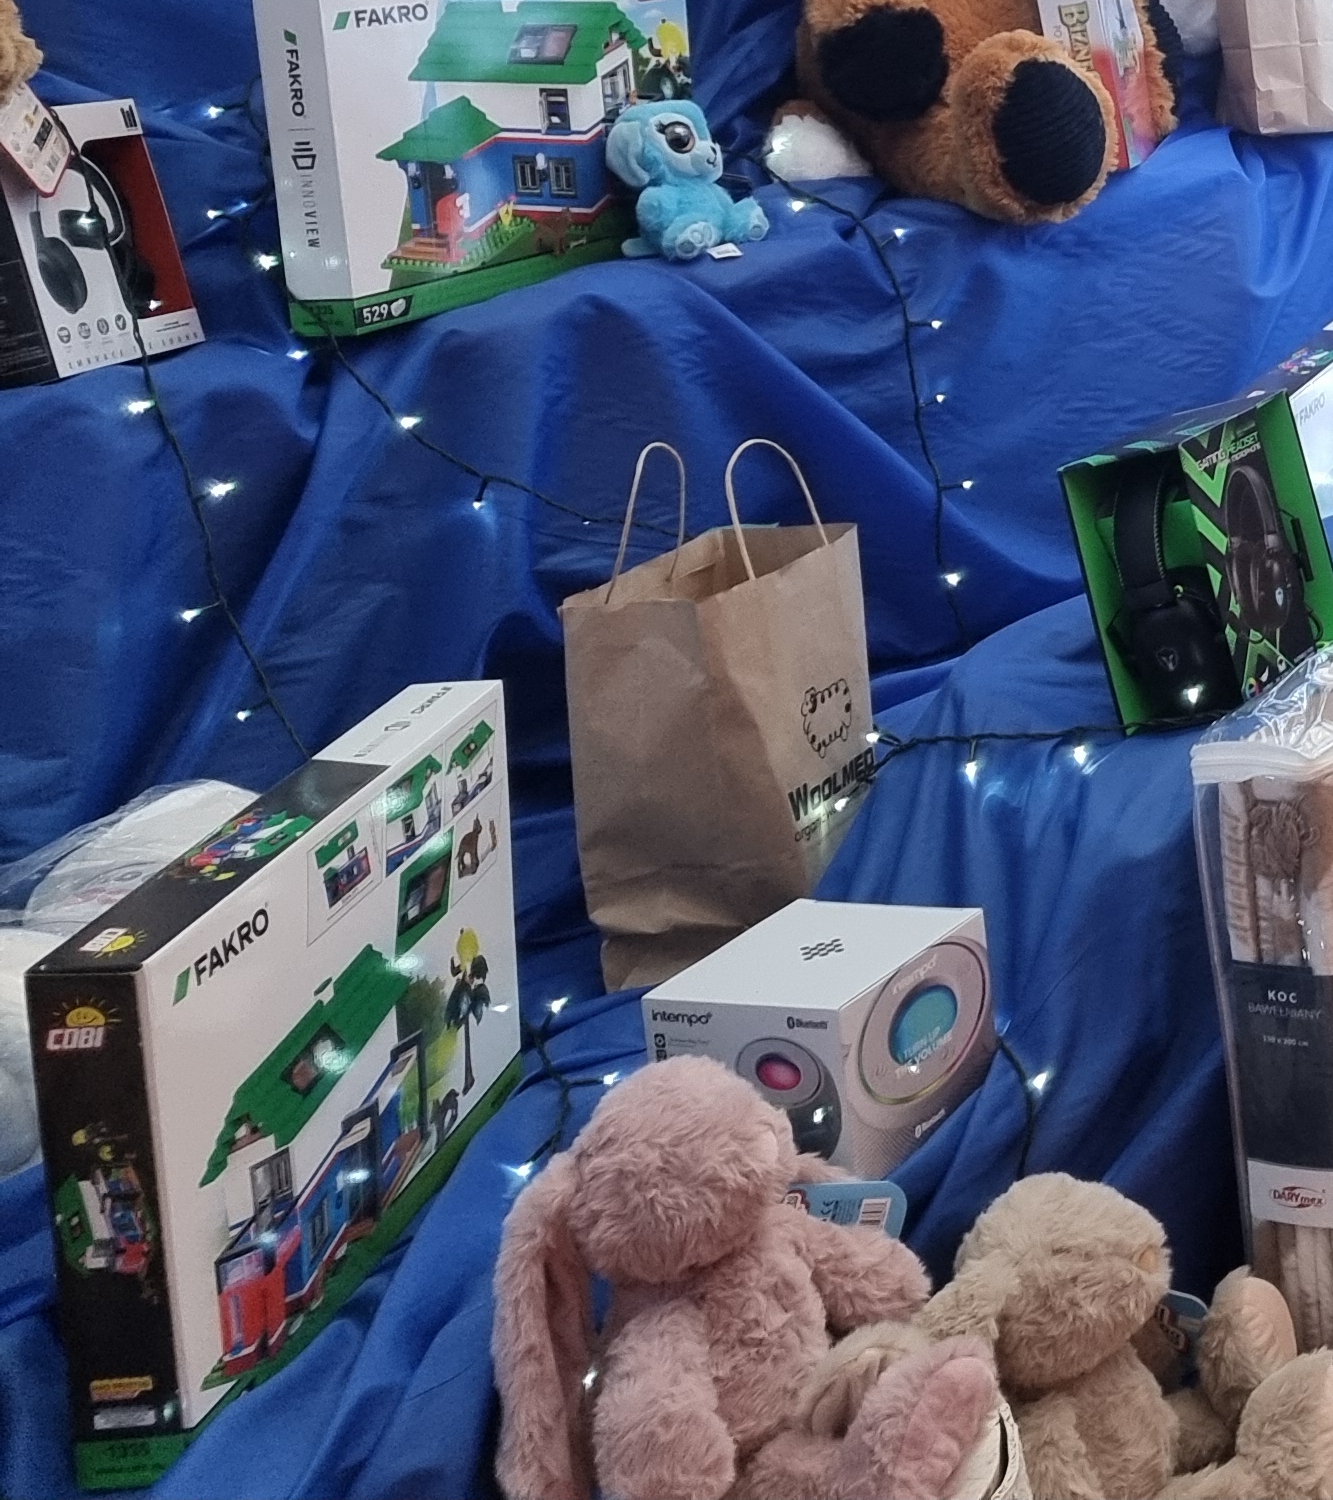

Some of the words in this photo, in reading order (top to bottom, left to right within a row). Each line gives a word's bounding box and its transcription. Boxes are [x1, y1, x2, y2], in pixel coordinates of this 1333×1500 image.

[354, 3, 428, 28] FAKRO
[1058, 1, 1097, 72] BIZN
[286, 48, 305, 117] FAKRO
[300, 174, 320, 249] INNOVIEW
[363, 303, 388, 323] 529
[1299, 392, 1326, 426] FAKRO
[193, 908, 269, 987] FAKRO
[1267, 989, 1297, 1004] KOC
[46, 1026, 106, 1050] COBI
